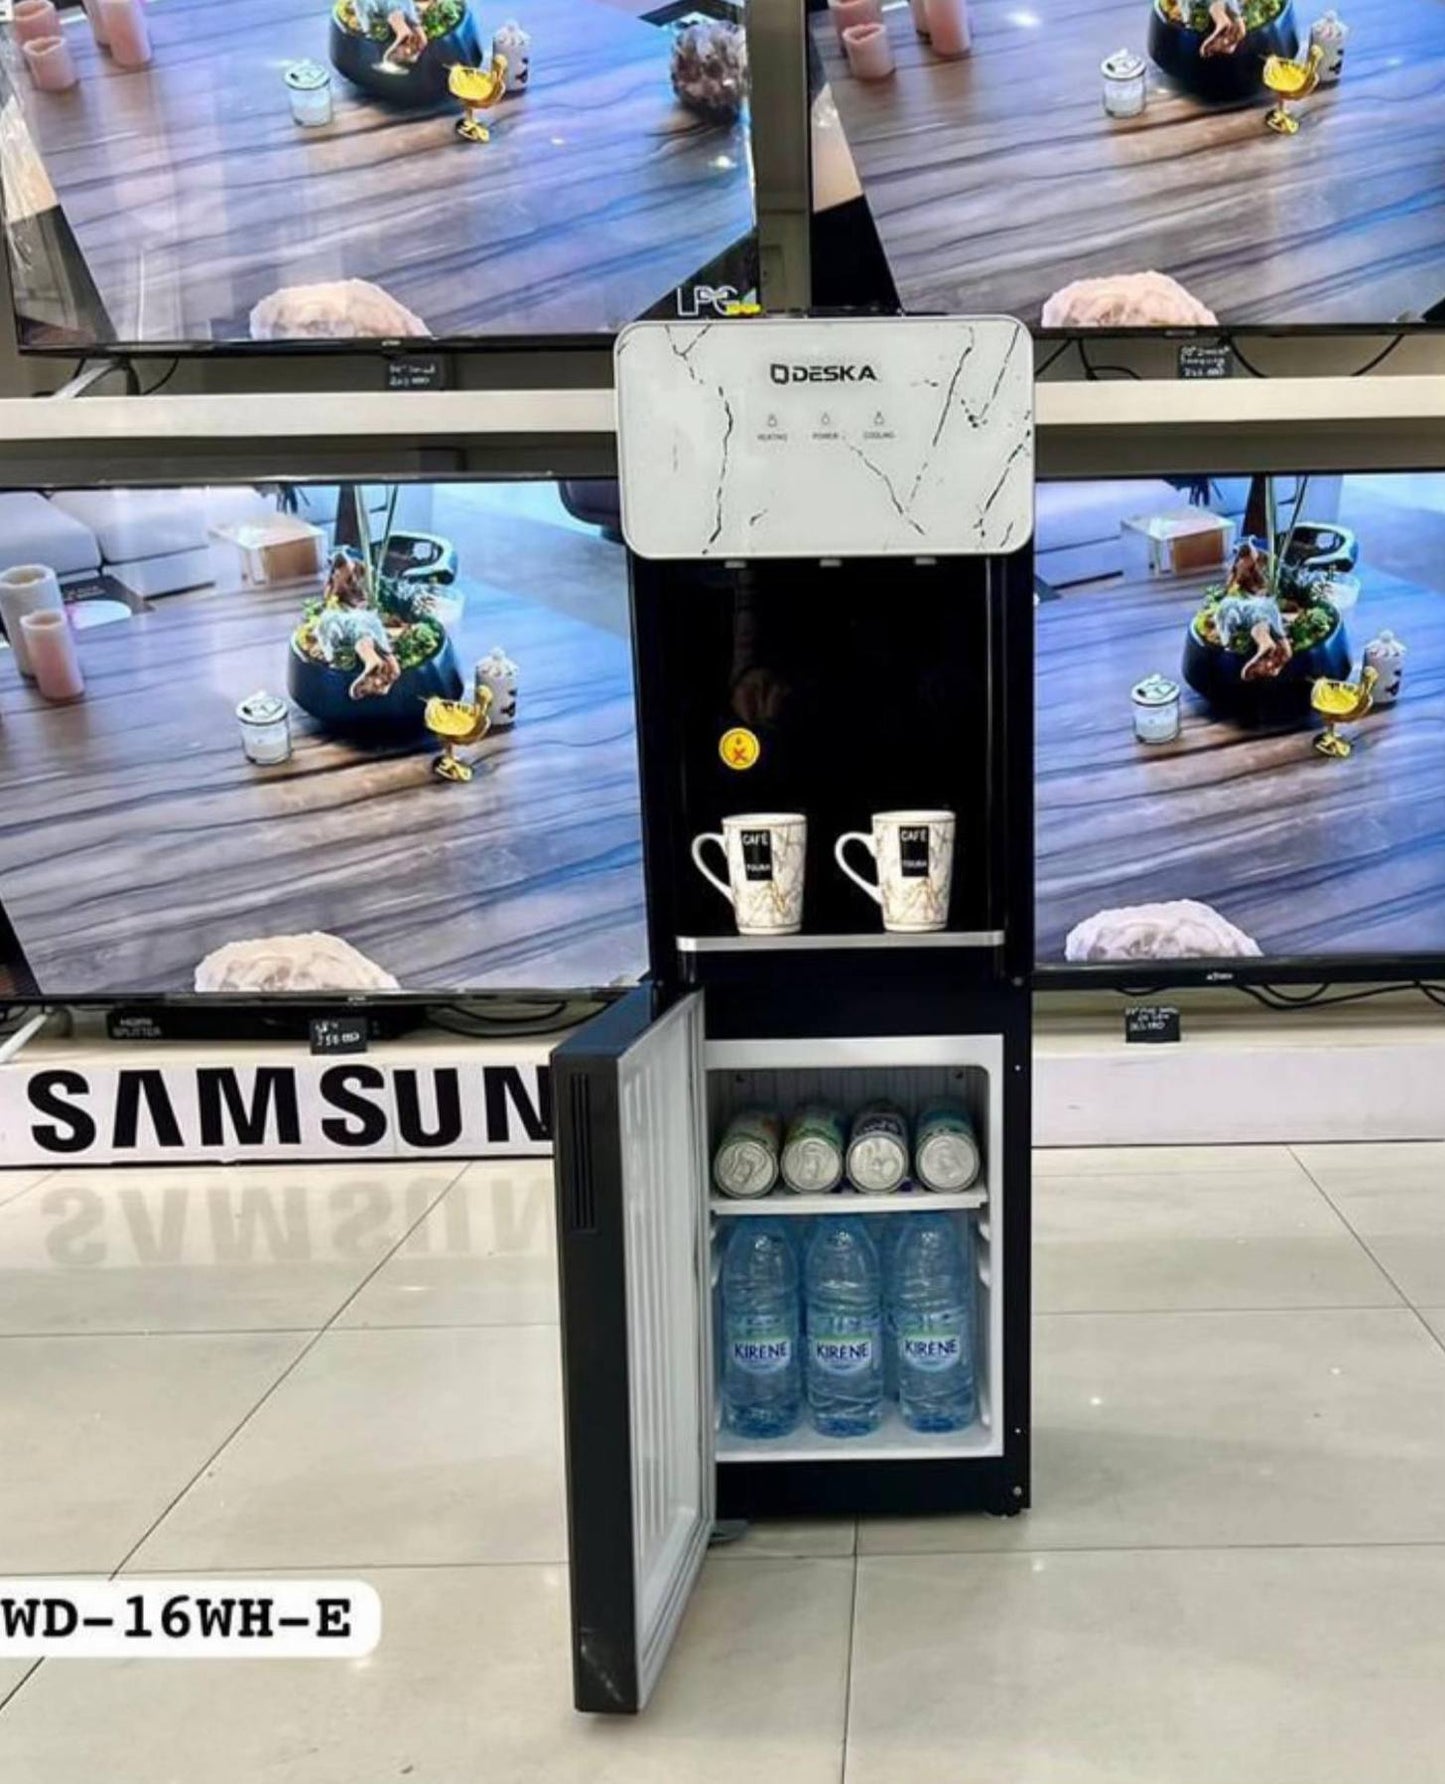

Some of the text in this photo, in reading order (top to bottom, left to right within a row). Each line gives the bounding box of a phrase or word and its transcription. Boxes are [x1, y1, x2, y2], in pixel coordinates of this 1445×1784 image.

[792, 365, 877, 382] DESKA
[812, 431, 839, 440] POWER
[734, 1341, 788, 1359] KIRENE
[816, 1341, 870, 1358] KIRENE
[905, 1338, 957, 1355] KIRENE
